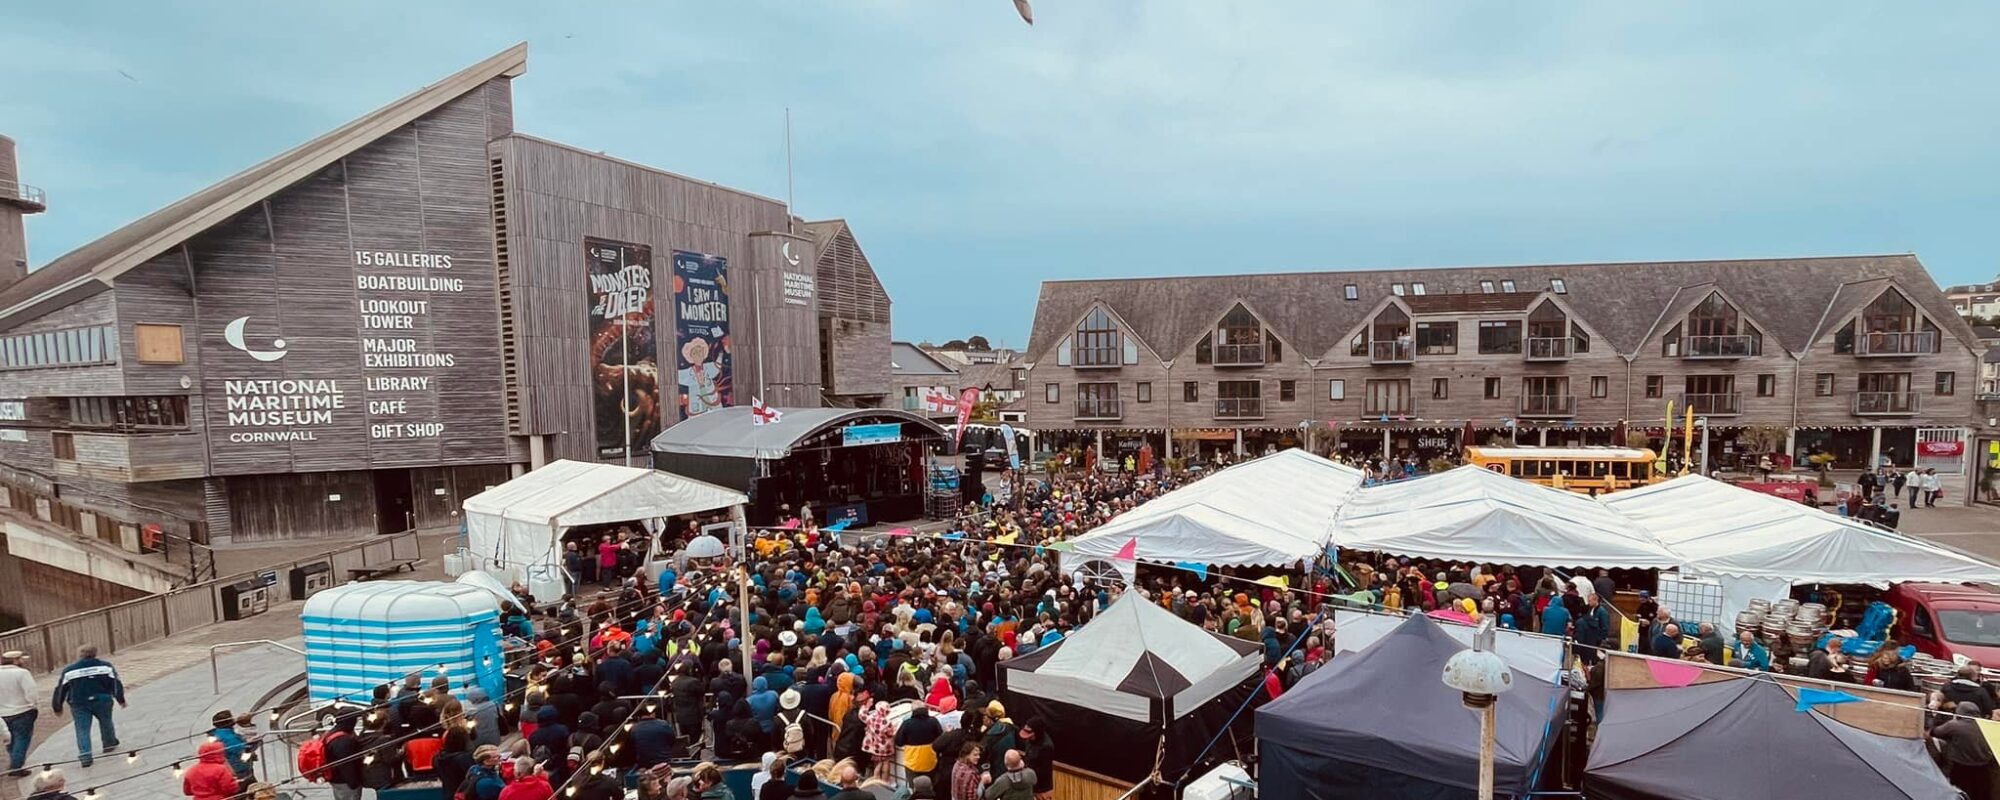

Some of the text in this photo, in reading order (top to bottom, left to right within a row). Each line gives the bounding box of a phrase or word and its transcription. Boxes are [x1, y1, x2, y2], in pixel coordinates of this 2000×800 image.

[356, 251, 452, 269] 15 GALLERIES
[357, 276, 463, 292] BOATBUILDING
[590, 265, 650, 293] MONSTERS
[784, 272, 813, 283] NATIONAL
[784, 280, 814, 291] MARITIME
[785, 288, 811, 297] MUSEUM
[687, 286, 719, 303] I SAW A
[360, 299, 427, 315] LOOKOUT
[605, 287, 647, 319] DEEP
[680, 302, 727, 321] MONSTER
[362, 315, 413, 329] TOWER
[364, 339, 416, 353] MAJOR
[365, 353, 455, 367] EXHIBITIONS
[225, 380, 343, 395] NATIONAL
[367, 377, 429, 391] LIBRARY
[227, 395, 345, 410] MARITIME
[369, 398, 407, 415] CAFÉ
[228, 410, 332, 426] MUSEUM
[230, 431, 317, 443] CORNWALL
[371, 422, 445, 439] GIFT SHOP
